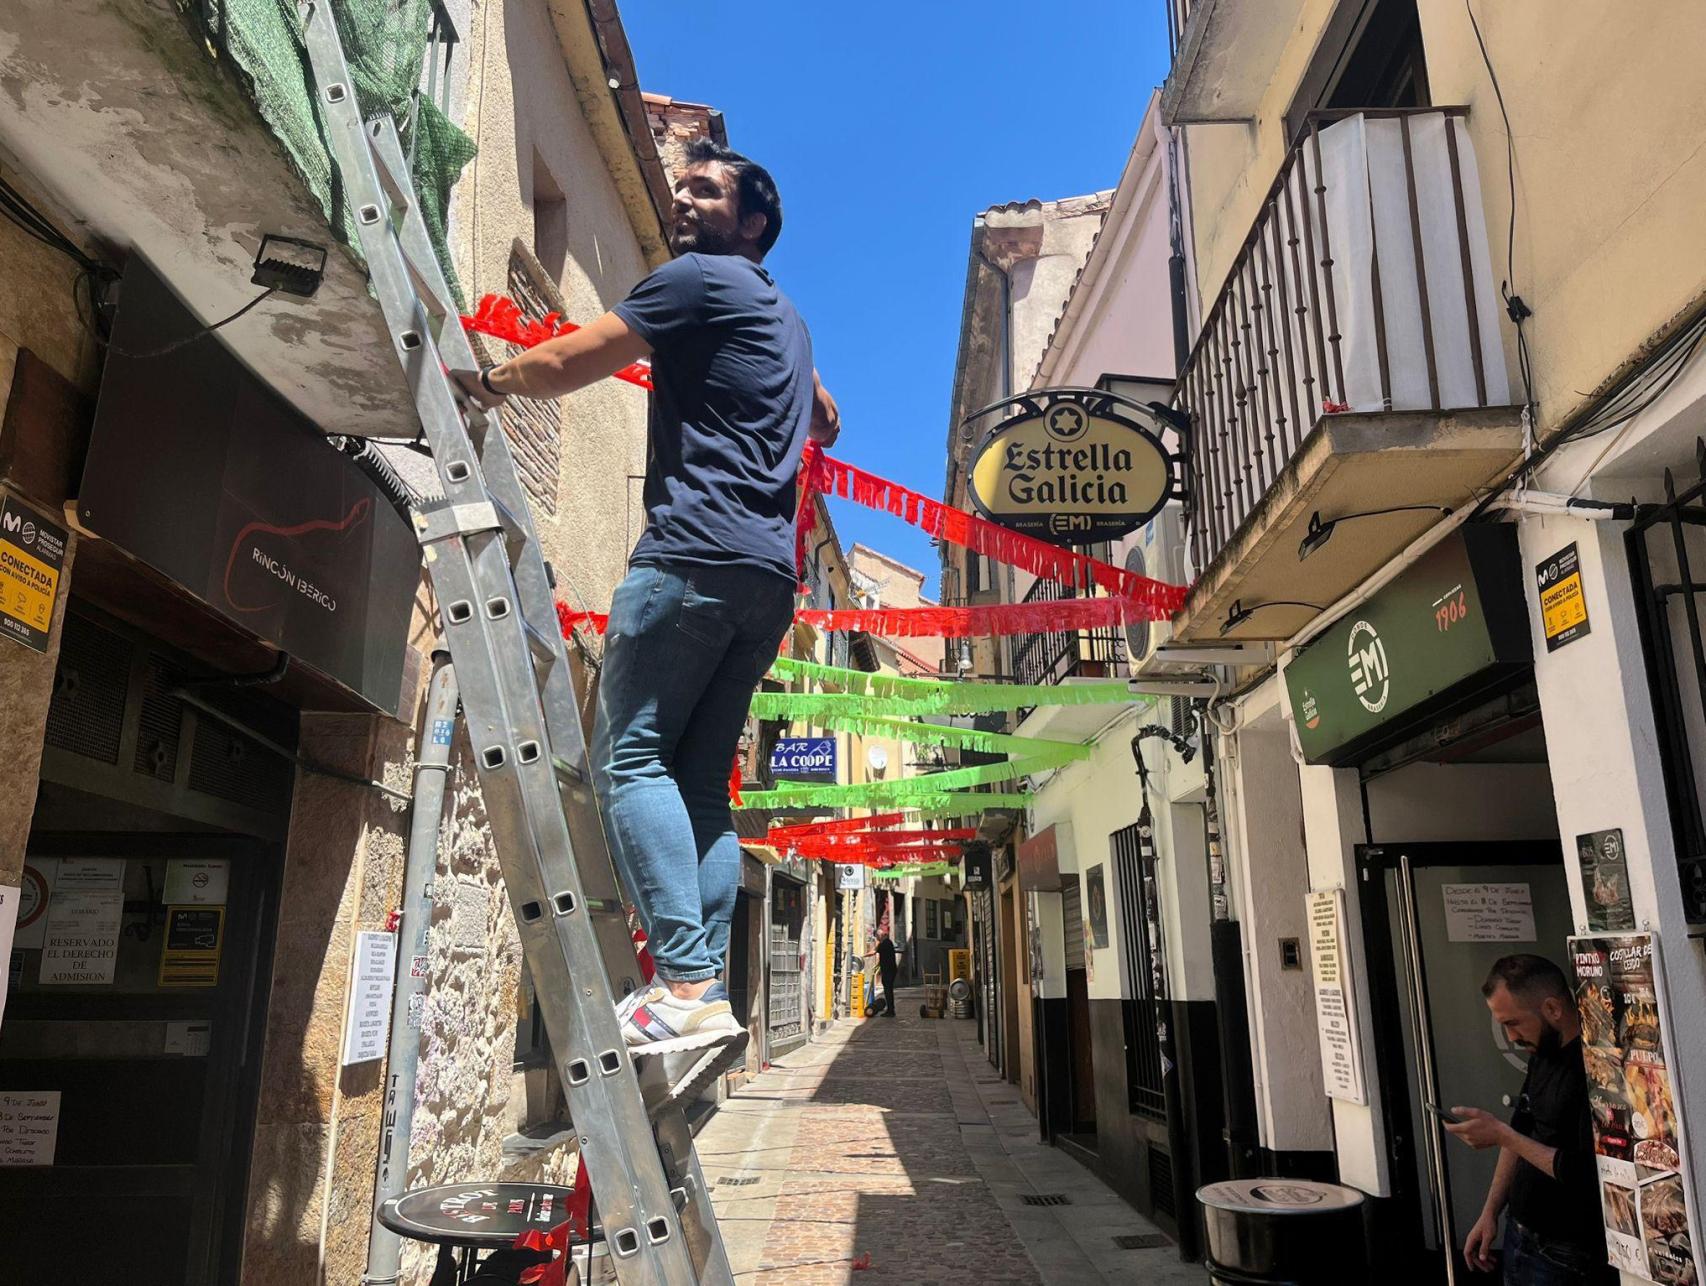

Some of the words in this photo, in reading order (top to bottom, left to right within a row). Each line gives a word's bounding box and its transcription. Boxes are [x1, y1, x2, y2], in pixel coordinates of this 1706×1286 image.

[1003, 442, 1133, 473] Estrella
[1008, 473, 1129, 505] Galicia
[39, 529, 63, 547] MOVISTAR
[38, 537, 64, 557] PROSEGUR
[0, 551, 53, 589] CONECTADA
[26, 579, 31, 588] A
[1544, 581, 1578, 606] CONECTADA
[1435, 591, 1466, 632] 1906
[775, 742, 808, 754] BAR
[771, 756, 788, 767] LA
[791, 755, 833, 767] COOPE
[49, 938, 114, 947] RESERVADO
[47, 950, 61, 959] EL
[62, 950, 114, 959] DERECHO
[1575, 953, 1600, 965] PINTXO
[72, 961, 87, 970] DE
[1577, 966, 1603, 977] MORUNO
